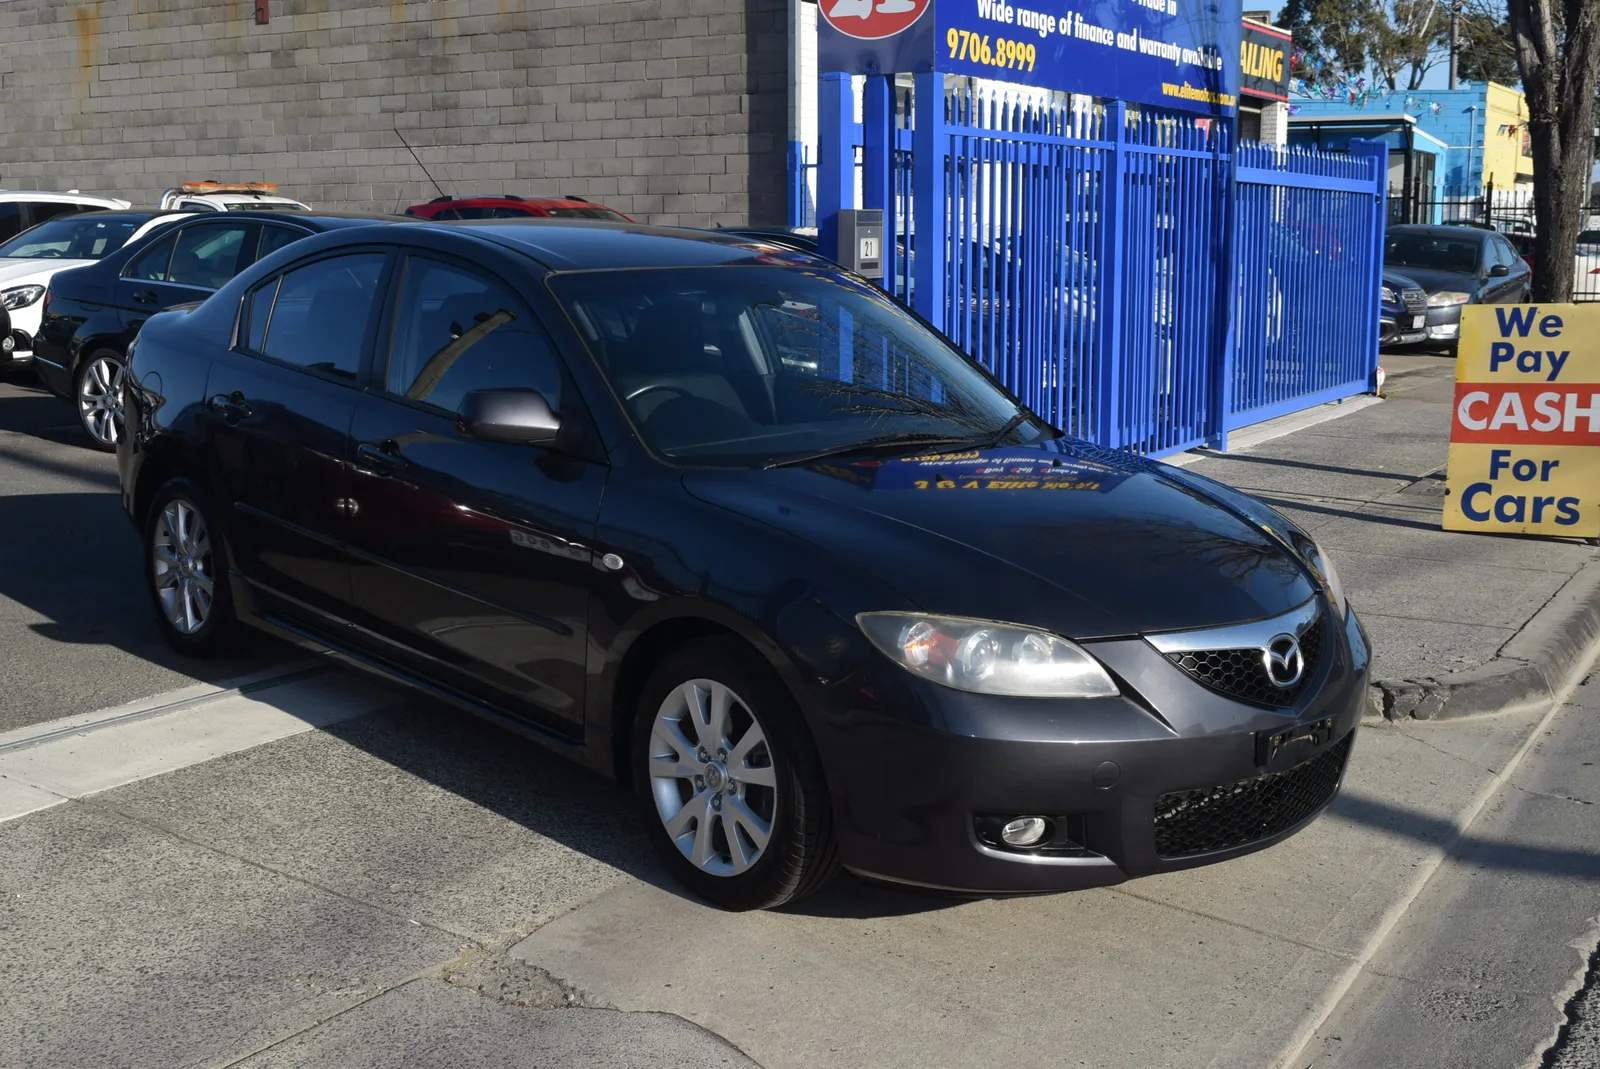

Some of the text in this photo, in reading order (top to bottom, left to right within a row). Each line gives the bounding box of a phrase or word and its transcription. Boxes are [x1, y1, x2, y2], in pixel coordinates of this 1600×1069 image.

[1138, 0, 1177, 16] ade in
[946, 27, 1036, 73] 9706.8999
[977, 0, 1223, 71] Wide range of finance and warranty available
[864, 241, 873, 257] 21
[1495, 306, 1564, 338] We
[1489, 341, 1571, 382] Pay
[1457, 390, 1600, 433] CASH
[1489, 449, 1560, 482] For
[1460, 481, 1580, 526] Cars
